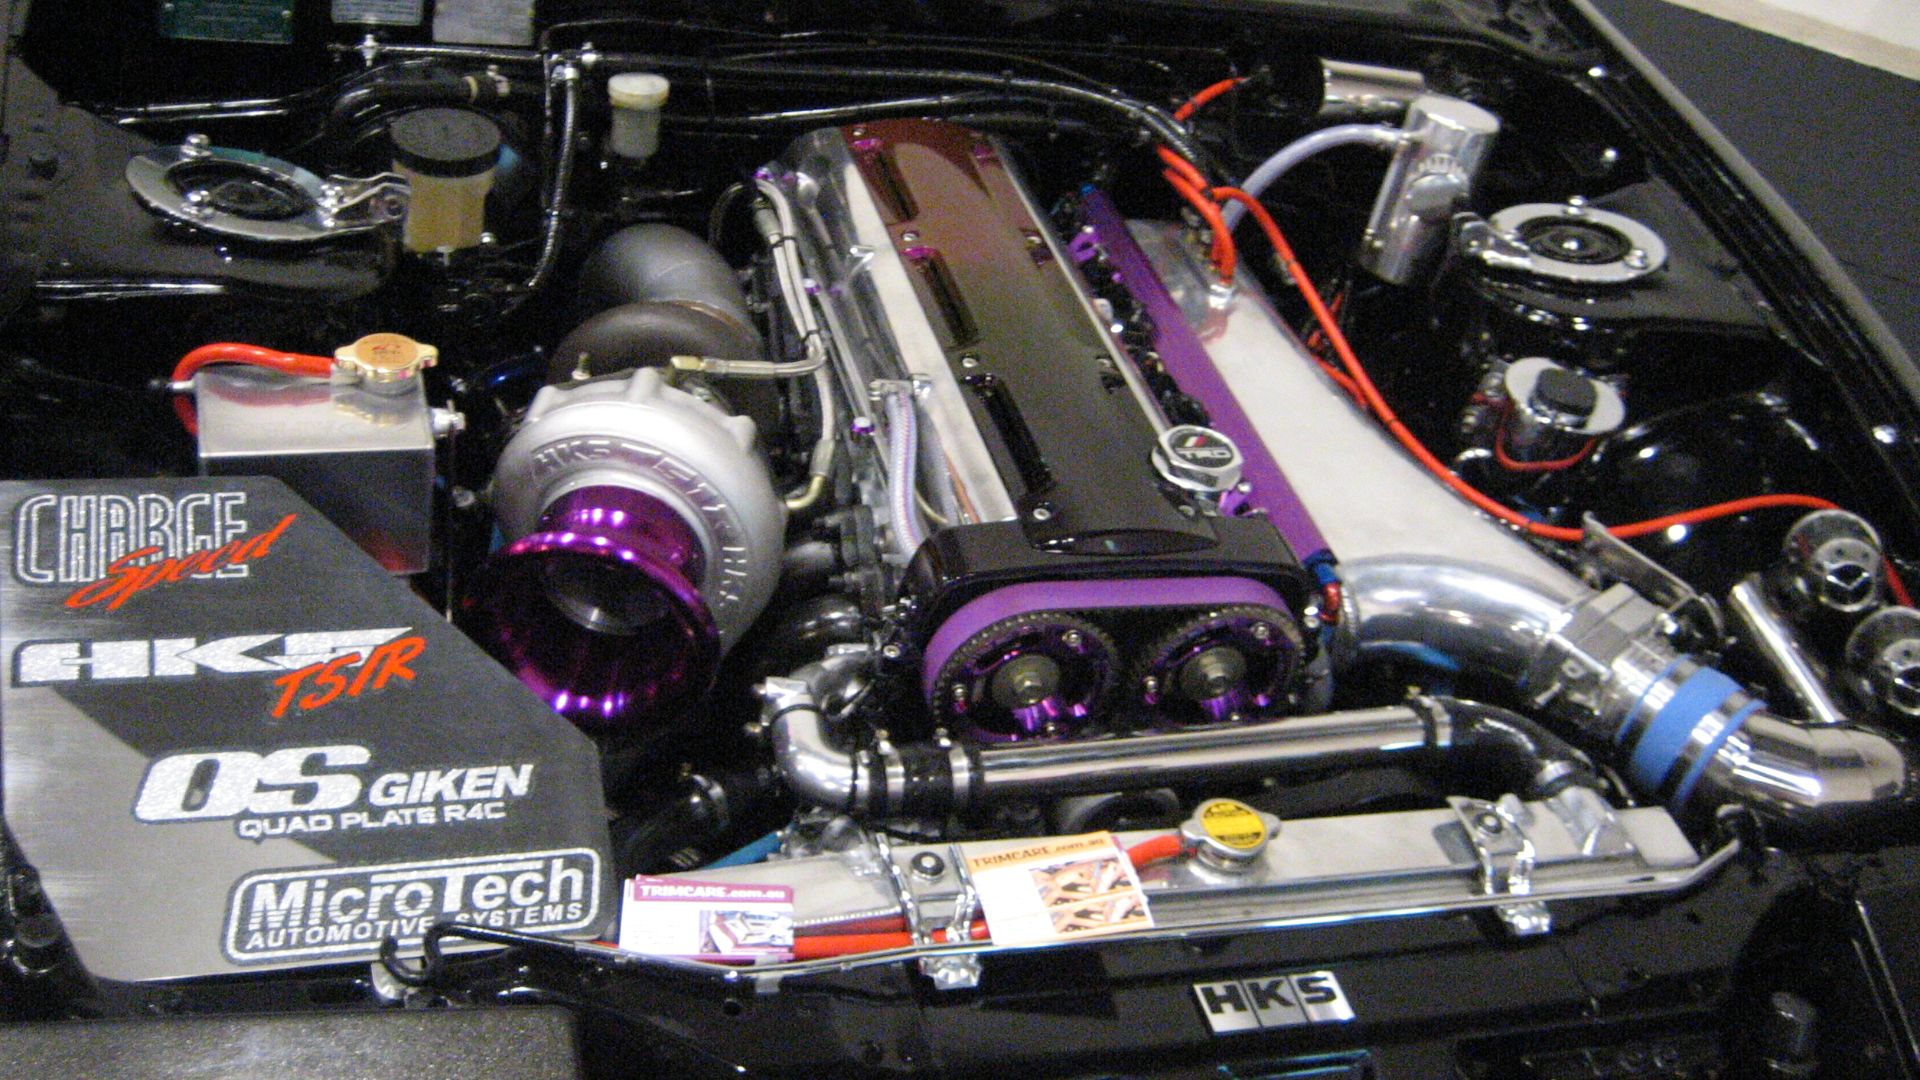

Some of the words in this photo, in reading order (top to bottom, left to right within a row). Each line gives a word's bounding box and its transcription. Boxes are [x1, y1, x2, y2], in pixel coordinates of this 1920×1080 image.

[17, 492, 248, 582] CHARGE
[14, 627, 413, 685] HKS
[136, 744, 372, 821] OS
[369, 764, 534, 807] GIKEN
[238, 814, 333, 838] QUAD
[340, 806, 435, 829] PLATE
[444, 801, 508, 823] R4C
[248, 858, 584, 930] MicroTech
[245, 915, 436, 950] AUTOMOTIVE
[455, 902, 583, 928] SYSTEMS
[1200, 976, 1337, 1014] HKS
